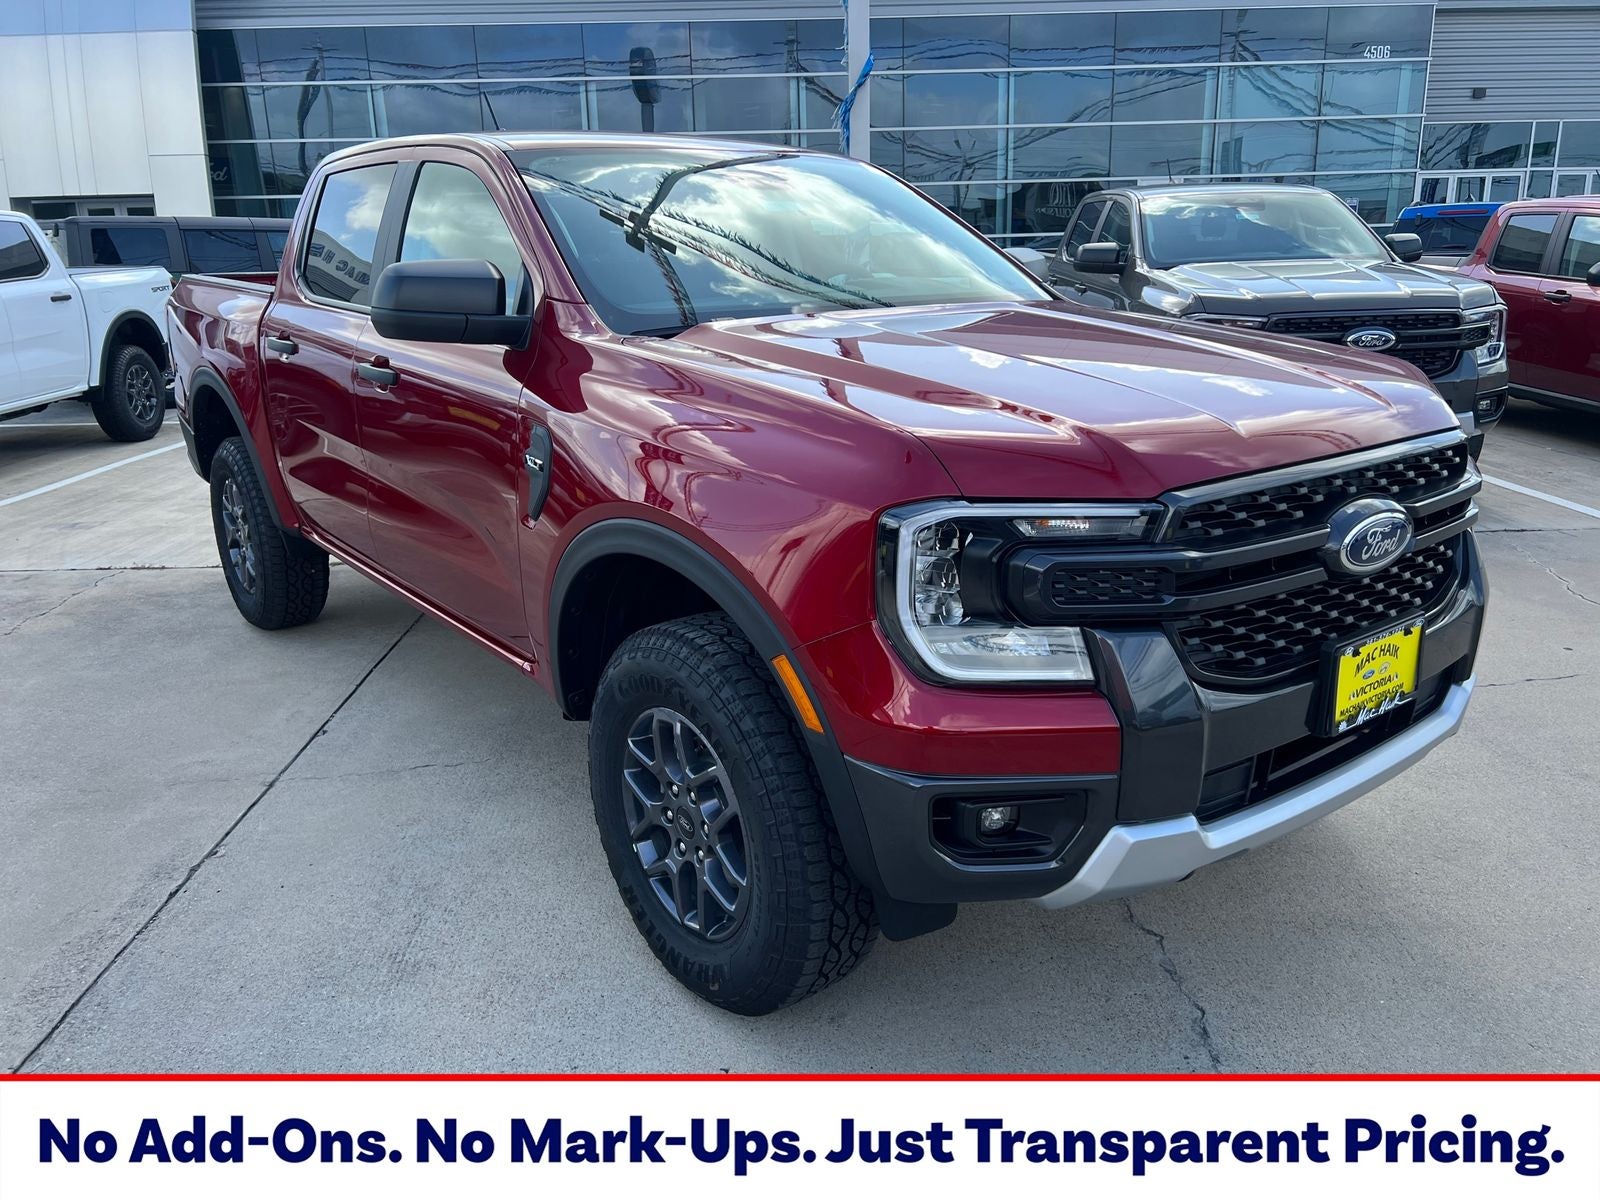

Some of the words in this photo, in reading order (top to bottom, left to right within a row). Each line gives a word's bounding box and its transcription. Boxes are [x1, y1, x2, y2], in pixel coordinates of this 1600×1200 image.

[1363, 45, 1391, 59] 4506
[1358, 334, 1386, 347] Ford
[1361, 524, 1401, 561] Ford
[1354, 646, 1378, 677] MAC
[1379, 643, 1400, 660] HAIK
[1354, 674, 1392, 699] VICTORIA
